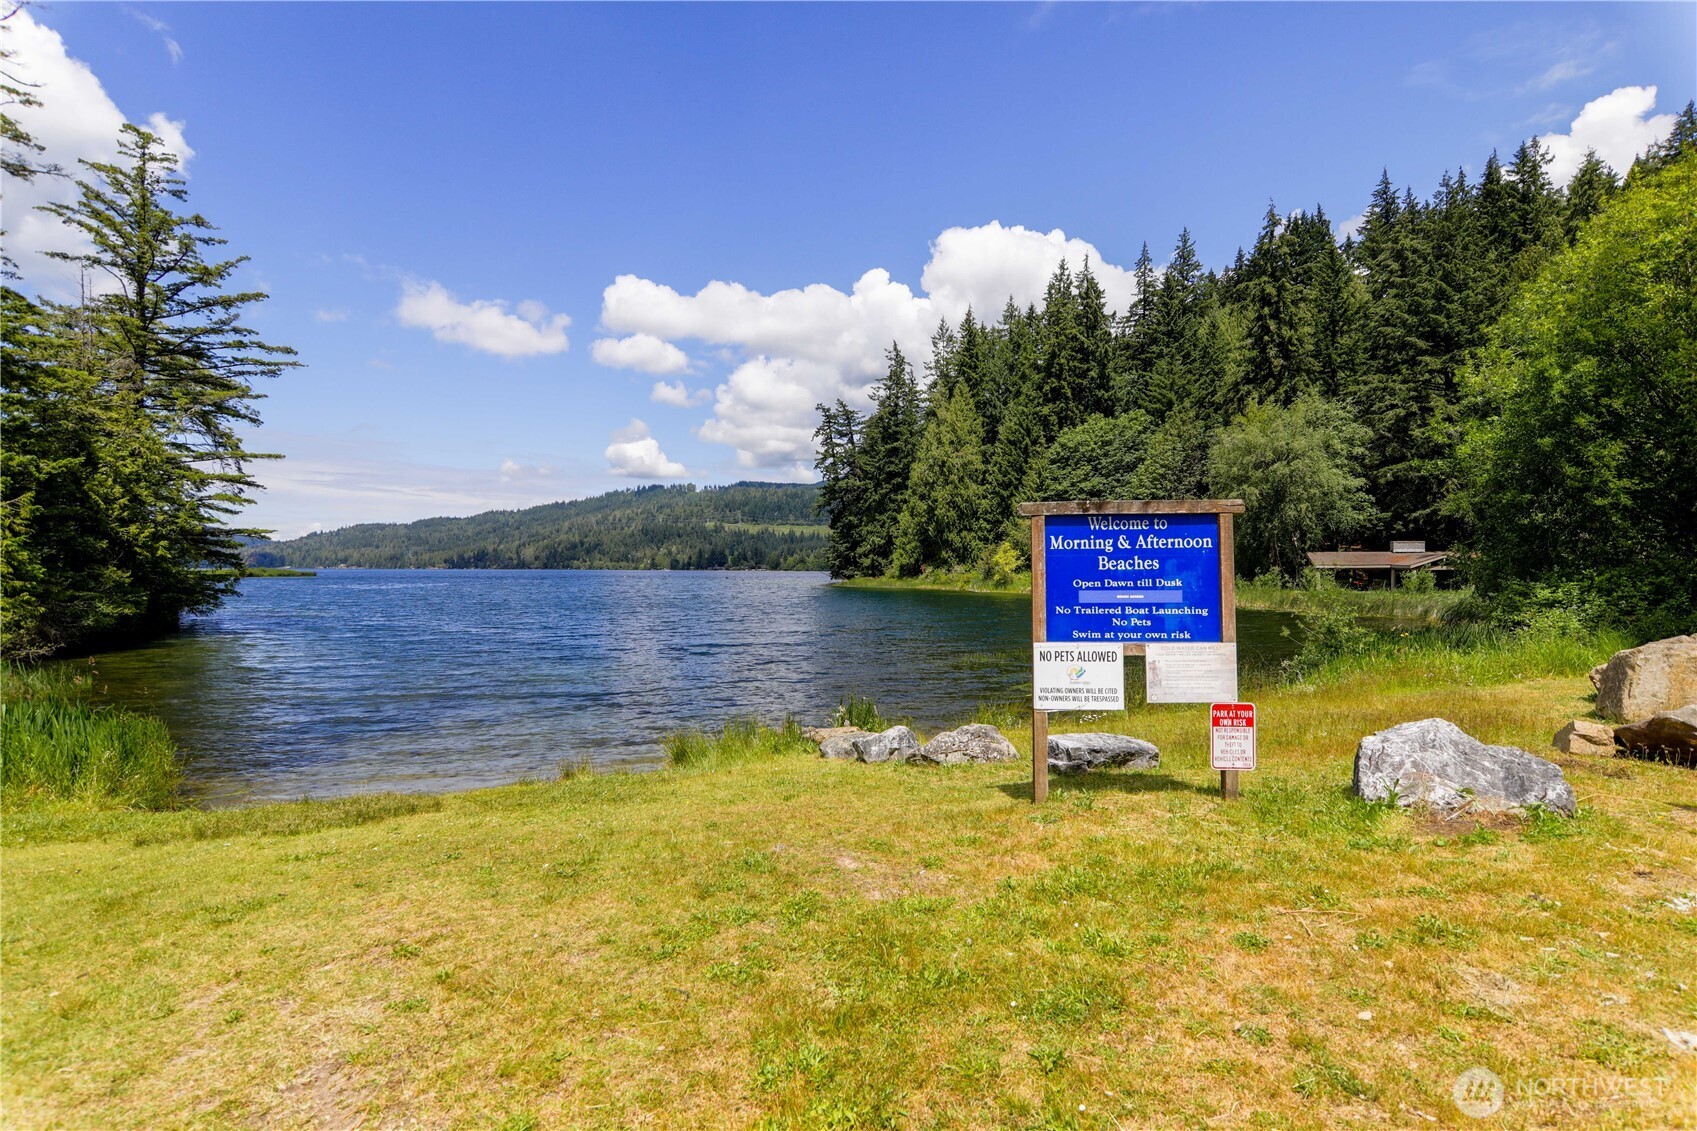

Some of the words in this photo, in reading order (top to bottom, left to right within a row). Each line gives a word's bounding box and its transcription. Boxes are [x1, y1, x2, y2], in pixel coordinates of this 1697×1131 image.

[1088, 517, 1149, 530] Welcome
[1154, 517, 1167, 529] to
[1050, 536, 1113, 552] Morning
[1118, 535, 1131, 549] &
[1135, 535, 1212, 549] Afternoon
[1098, 556, 1159, 570] Beaches
[1073, 580, 1101, 589] Open
[1104, 579, 1134, 587] Dawn
[1137, 579, 1152, 587] till
[1152, 607, 1208, 616] Launching
[1112, 618, 1127, 626] No
[1131, 618, 1151, 626] Pets
[1118, 632, 1141, 640] your
[1171, 630, 1190, 638] risk
[1040, 651, 1052, 661] NO
[1055, 651, 1074, 661] PETS
[1077, 651, 1117, 662] ALLOWED
